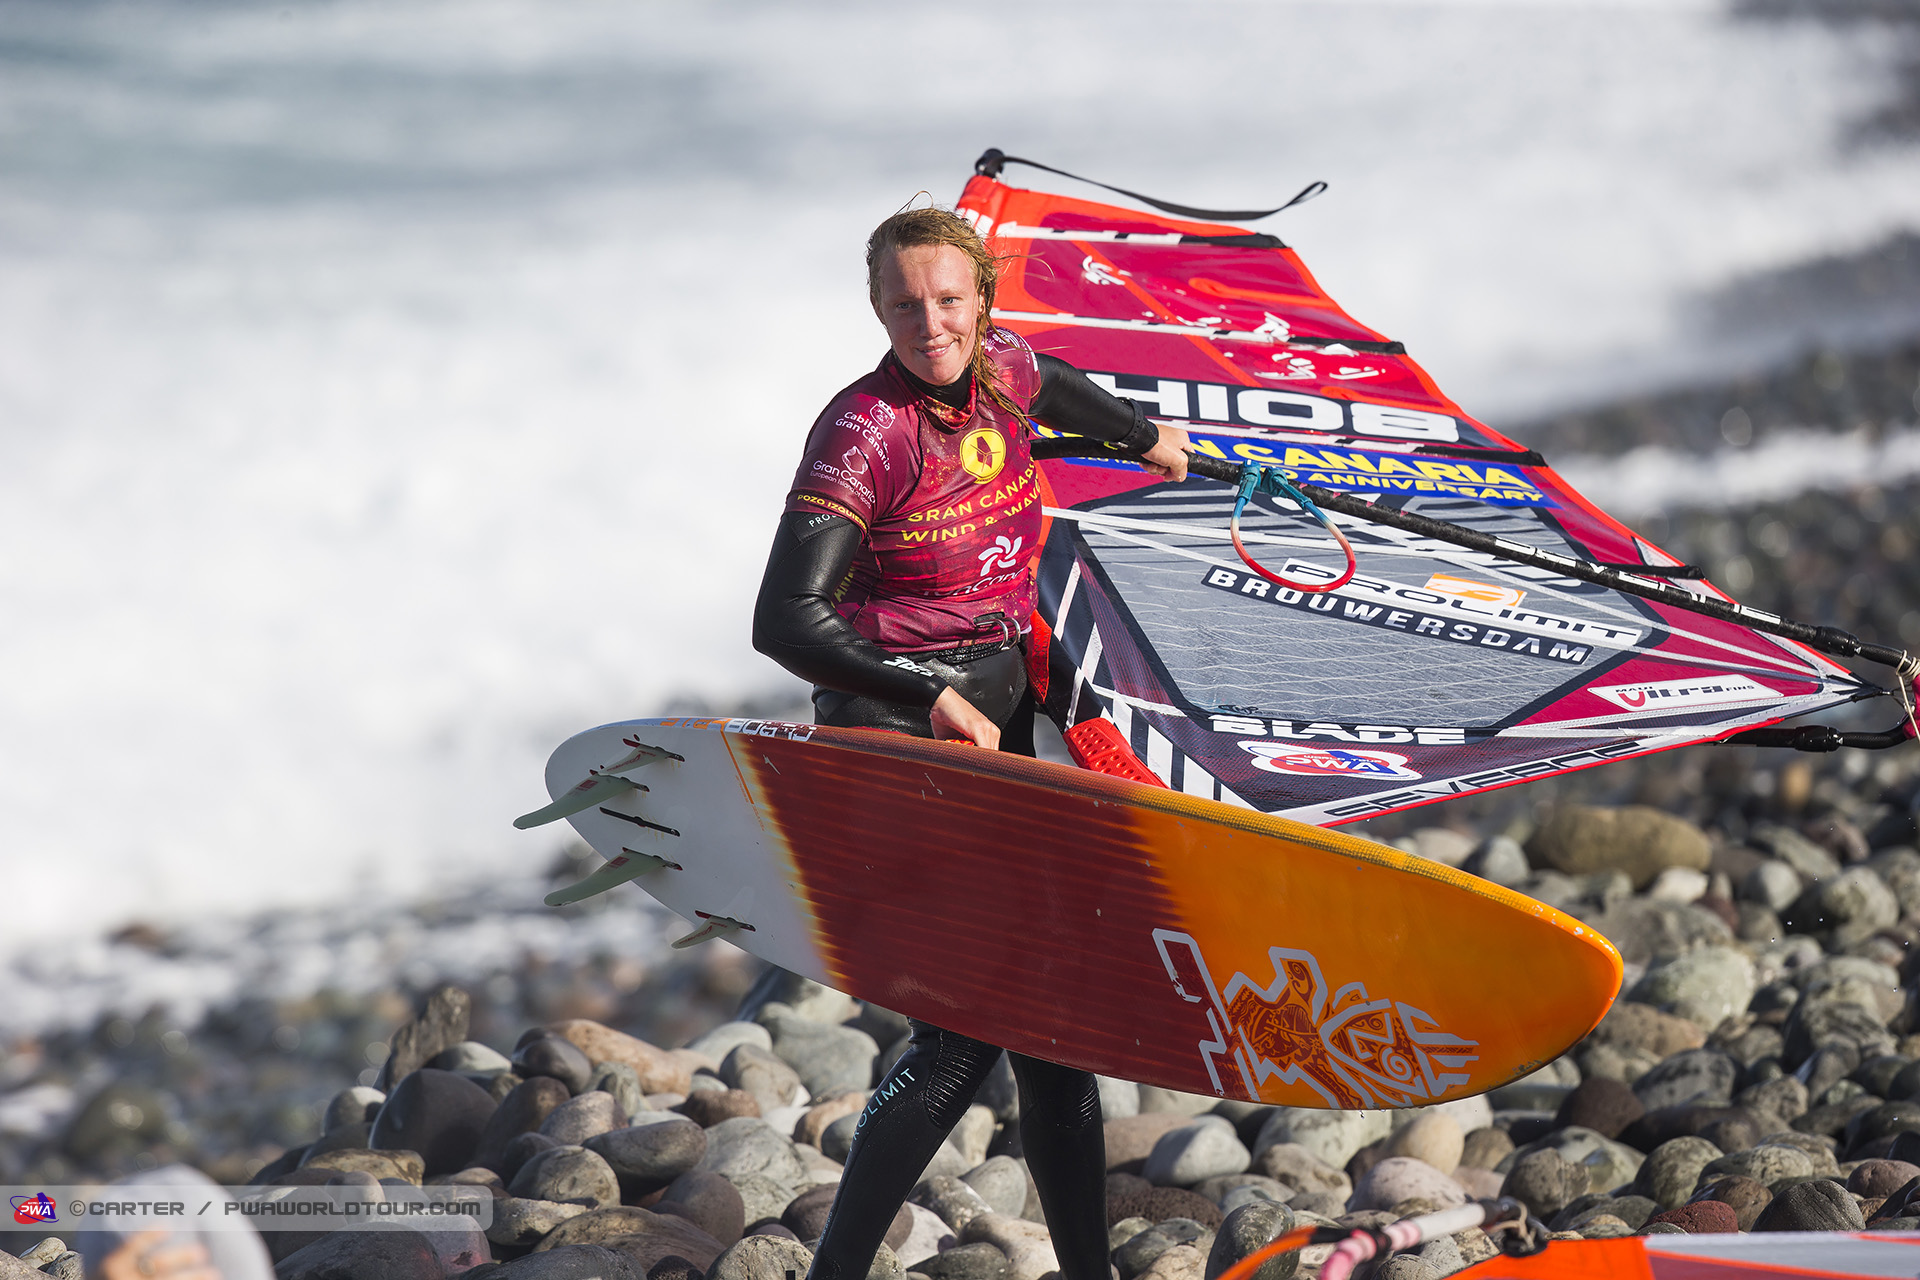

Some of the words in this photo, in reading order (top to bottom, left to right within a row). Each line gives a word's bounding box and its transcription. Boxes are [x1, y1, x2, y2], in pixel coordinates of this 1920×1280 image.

[844, 410, 883, 441] Cabildo
[835, 418, 861, 433] Gran
[861, 429, 890, 471] Canaria
[1232, 442, 1538, 490] CANARIA
[1307, 471, 1544, 502] ANNIVERSARY
[907, 501, 973, 522] GRAN
[901, 523, 976, 542] WIND
[984, 516, 998, 526] &
[1207, 567, 1594, 665] BROUWERSDAM
[1208, 714, 1466, 745] BLADE
[1285, 755, 1381, 771] PWA
[1303, 754, 1346, 762] WORLD
